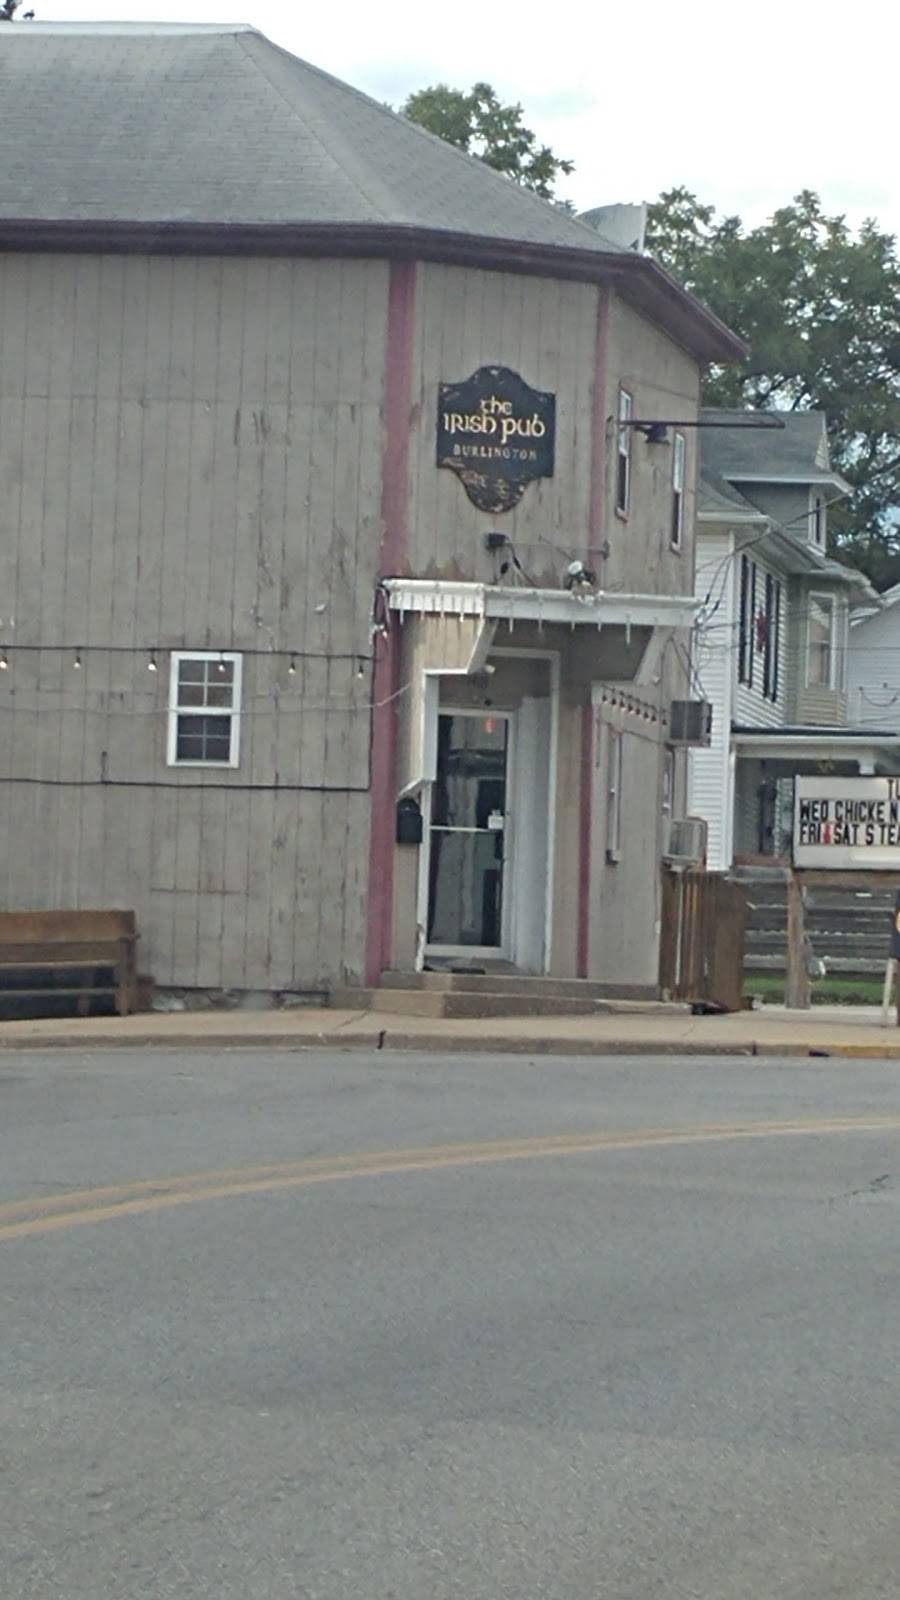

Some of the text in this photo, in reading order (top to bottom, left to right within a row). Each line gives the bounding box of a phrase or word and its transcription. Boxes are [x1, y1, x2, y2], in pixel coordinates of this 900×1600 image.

[480, 395, 513, 415] the
[501, 413, 546, 444] pub
[453, 444, 537, 461] BURLINGTON
[834, 823, 860, 845] SAT
